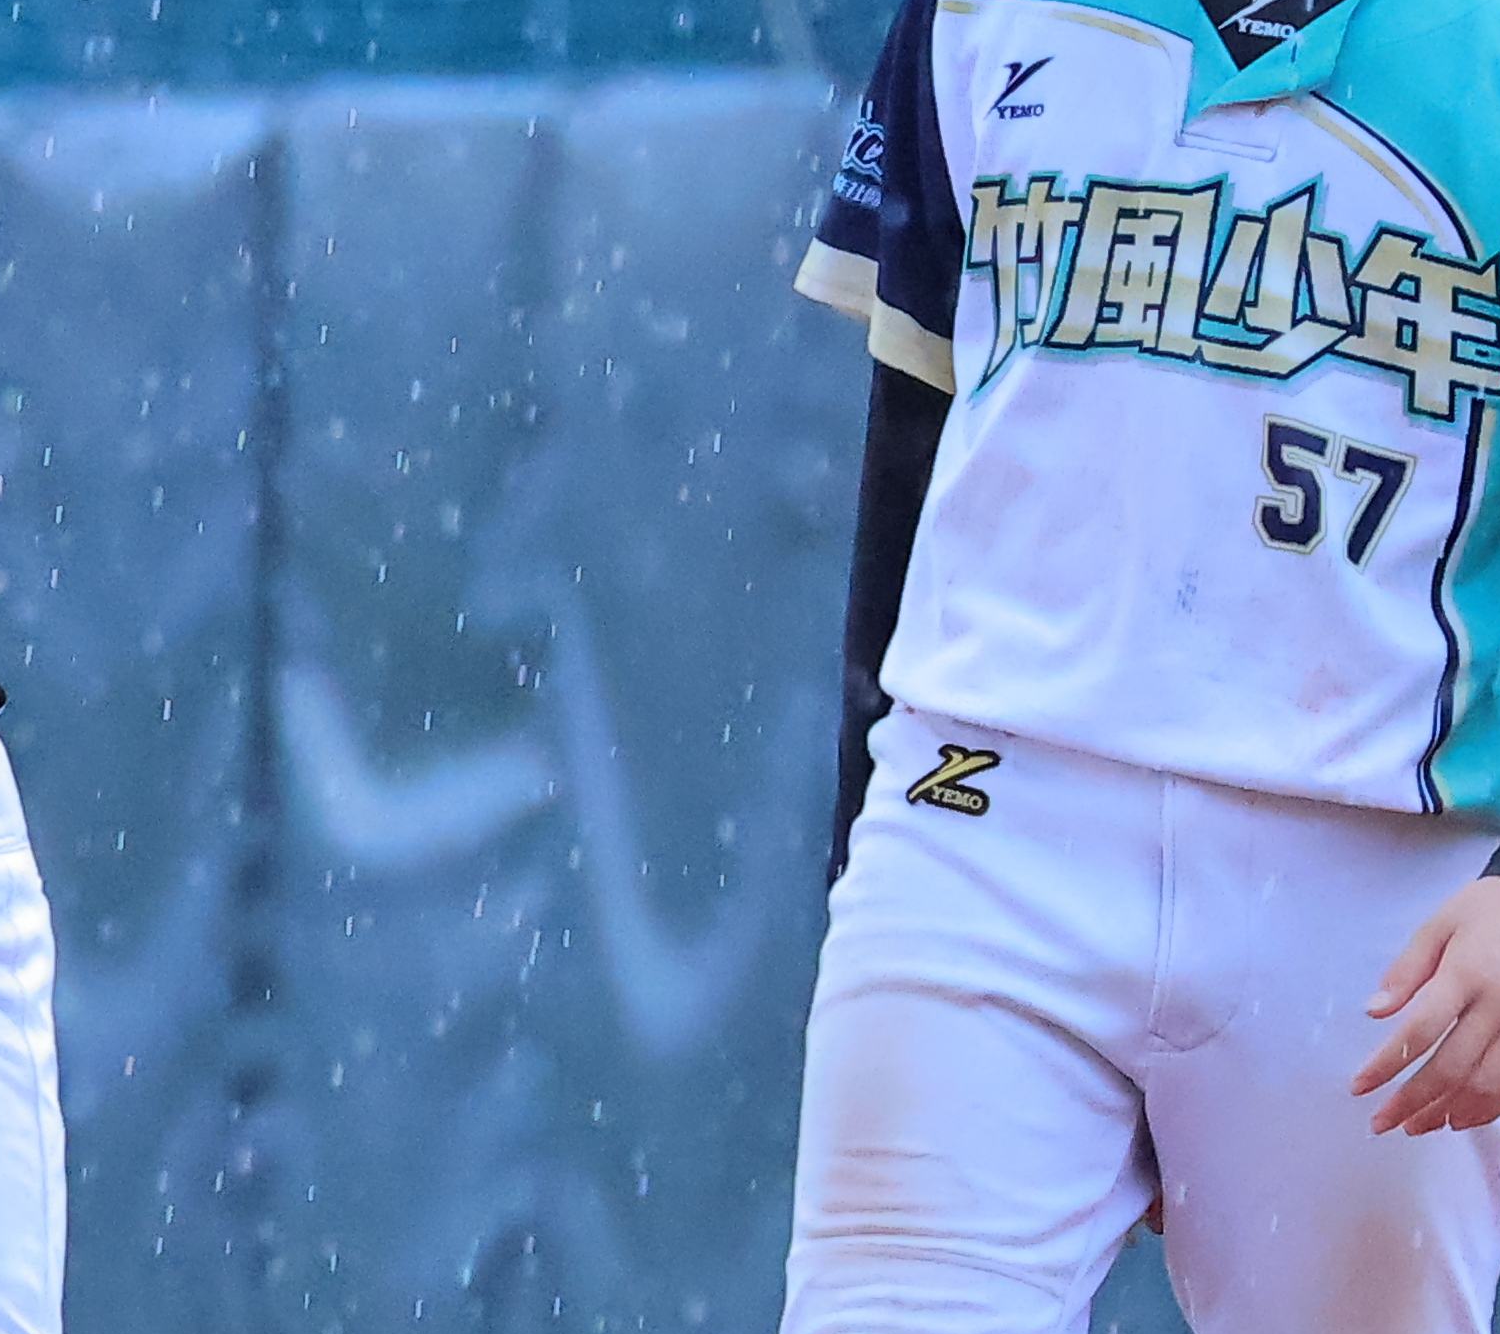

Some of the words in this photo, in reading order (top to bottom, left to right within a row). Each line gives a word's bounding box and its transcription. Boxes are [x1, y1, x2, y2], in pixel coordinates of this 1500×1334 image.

[1236, 17, 1295, 38] YEMO
[997, 104, 1045, 119] YEMO
[1254, 413, 1417, 574] 57
[931, 785, 983, 809] YEMO
